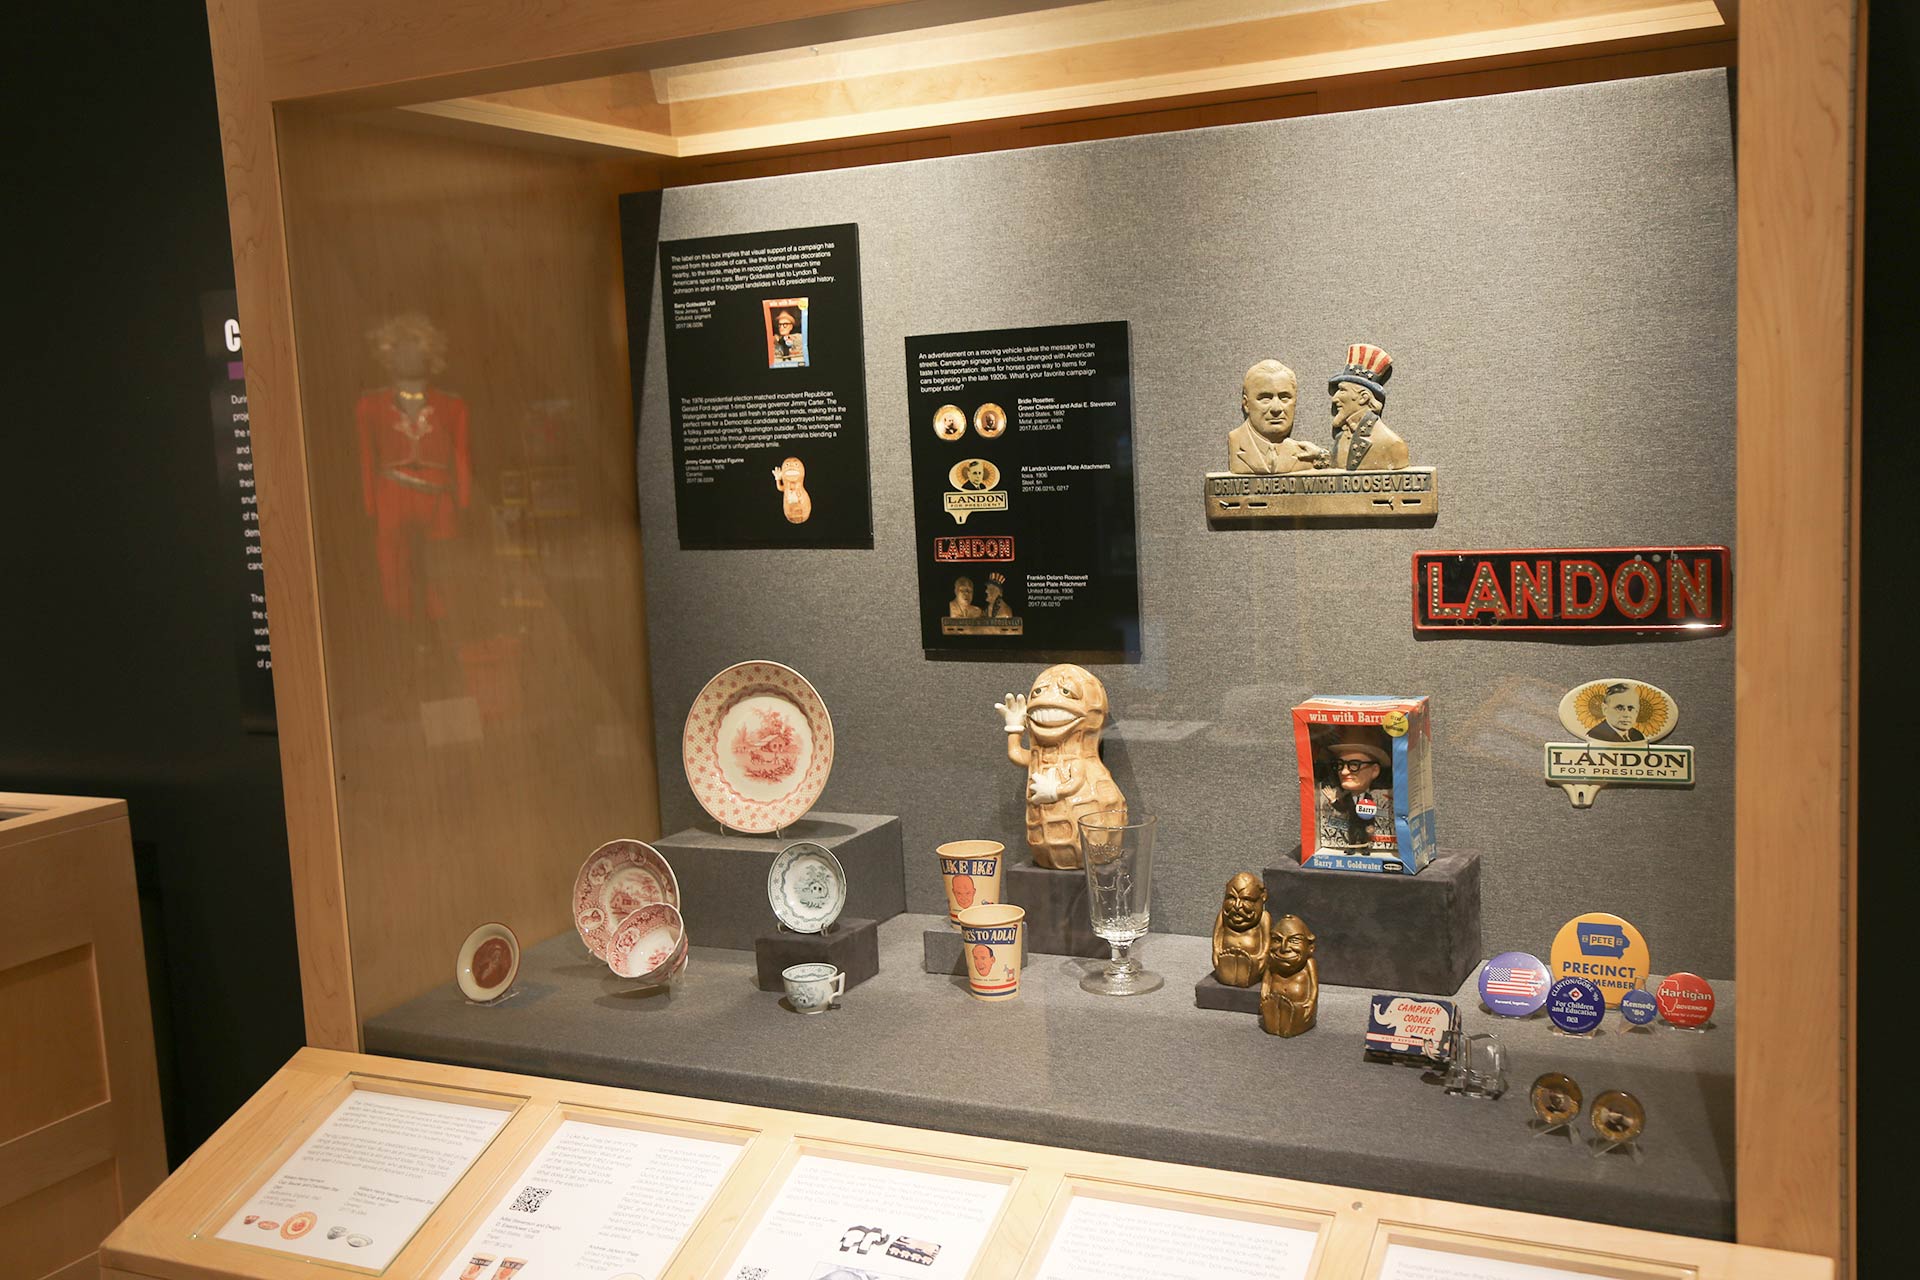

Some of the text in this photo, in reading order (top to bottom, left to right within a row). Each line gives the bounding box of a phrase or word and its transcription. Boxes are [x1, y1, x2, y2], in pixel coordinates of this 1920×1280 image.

[673, 277, 698, 286] Americans
[699, 276, 714, 285] spend
[734, 273, 748, 283] Barry
[749, 271, 774, 280] Goldwater
[792, 268, 811, 278] Lyndon
[673, 285, 693, 294] Johnson
[725, 282, 743, 291] biggest
[745, 280, 770, 288] landslides
[786, 276, 815, 287] presidential
[816, 274, 835, 284] history.
[927, 350, 965, 359] advertisement
[980, 347, 1000, 357] moving
[1050, 344, 1077, 353] message
[939, 358, 968, 368] Campaign
[970, 356, 992, 366] signage
[1002, 354, 1025, 362] vehicles
[1026, 353, 1052, 363] changed
[1066, 350, 1094, 359] American
[933, 375, 960, 385] beginning
[1066, 368, 1096, 378] campaign
[921, 384, 941, 393] bumper
[704, 395, 732, 405] presidential
[804, 390, 833, 400] Republican
[1214, 474, 1427, 495] DRIVE AHEAD WITH ROOSEVELT
[948, 495, 1004, 504] LANDON
[938, 539, 1010, 559] LANDON
[1427, 559, 1711, 620] LANDON
[251, 594, 264, 603] The
[1309, 712, 1328, 722] win
[1332, 711, 1354, 723] with
[1358, 712, 1385, 724] Barry
[1553, 751, 1686, 768] LANDON
[1593, 768, 1678, 777] PRESIDENT
[1358, 806, 1374, 814] Barry
[941, 859, 994, 876] LIKE IKE
[1314, 859, 1332, 867] Barry
[1347, 860, 1381, 870] Goldwater
[977, 930, 989, 941] TO
[992, 930, 1015, 941] ADLAI
[1591, 936, 1613, 946] PETE
[1563, 962, 1636, 978] PRECINCT
[1551, 977, 1594, 997] CLINTON/GORE
[1593, 979, 1635, 989] MEMBER
[1661, 988, 1712, 1001] Hartigan
[1398, 1003, 1442, 1016] CAMPAIGN
[1567, 1002, 1594, 1010] Children
[1623, 1000, 1655, 1010] Kennedy
[1403, 1014, 1432, 1024] COOKIE
[1566, 1008, 1597, 1017] Education
[1405, 1024, 1436, 1036] CUTTER
